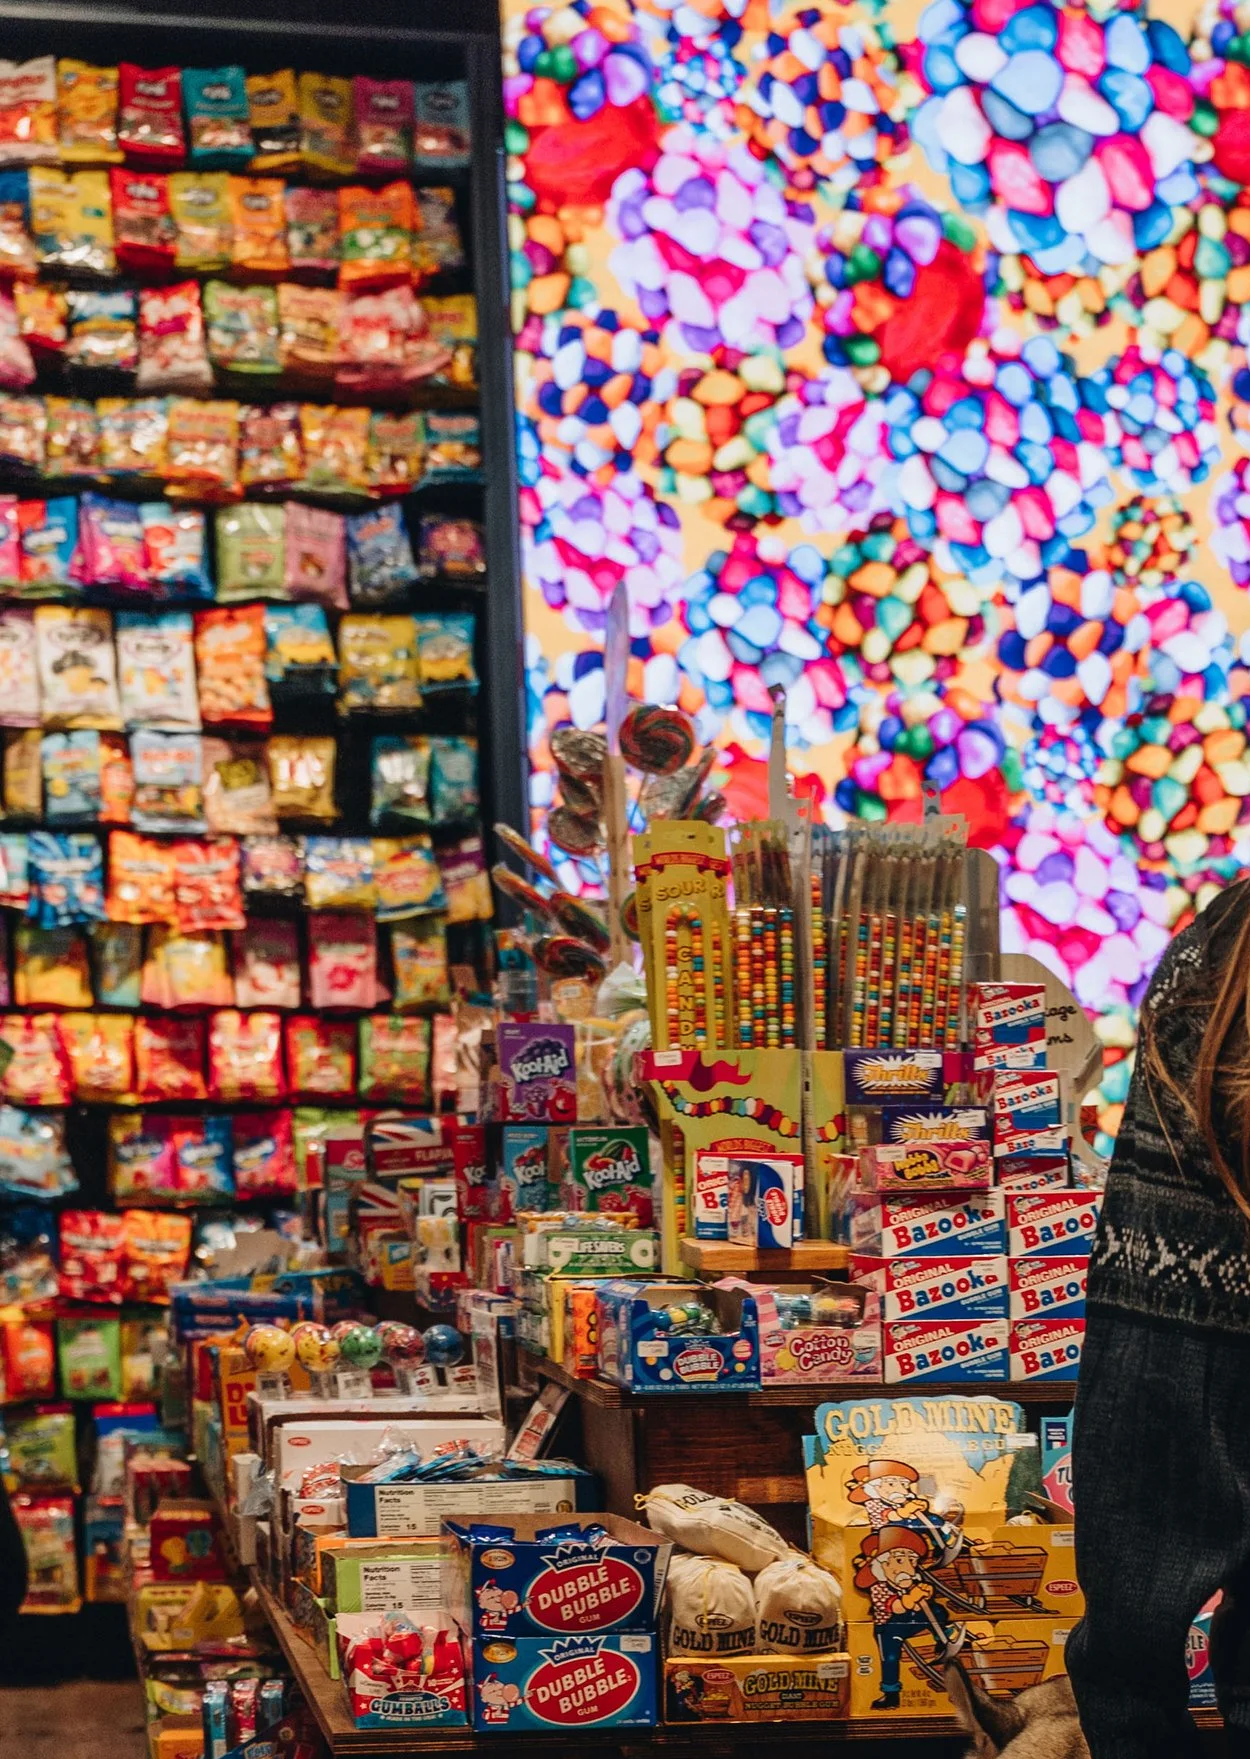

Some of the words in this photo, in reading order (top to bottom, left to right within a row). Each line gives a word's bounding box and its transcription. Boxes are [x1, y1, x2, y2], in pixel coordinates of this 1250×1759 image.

[656, 879, 706, 901] SOUR
[983, 999, 1040, 1024] Bazooka
[511, 1049, 570, 1082] Kool-Aid
[996, 1085, 1054, 1110] Bazooka
[584, 1154, 641, 1190] Kool-Aid
[889, 1199, 951, 1226] ORIGINAL
[1017, 1198, 1079, 1226] ORIGINAL
[892, 1203, 996, 1250] Bazooka
[893, 1262, 955, 1290] ORIGINAL
[1018, 1262, 1080, 1290] ORIGINAL
[895, 1269, 999, 1314] Bazooka
[790, 1334, 849, 1356] Cotton
[893, 1326, 955, 1353] ORIGINAL
[1018, 1325, 1080, 1352] ORIGINAL
[799, 1347, 853, 1371] Candy
[895, 1333, 999, 1377] Bazooka
[1020, 1343, 1080, 1376] Bazo
[824, 1401, 918, 1444] GOLD
[922, 1401, 1017, 1435] MINE
[556, 1553, 599, 1568] ORIGINAL
[537, 1565, 609, 1610] DUBBLE
[559, 1577, 631, 1622] BUBBLE
[578, 1613, 601, 1624] GUM
[672, 1625, 713, 1651] GOLD
[716, 1626, 756, 1651] MINE
[759, 1619, 802, 1645] GOLD
[803, 1624, 841, 1649] MINE
[553, 1646, 595, 1661] ORIGINAL
[535, 1658, 606, 1704] DUBBLE
[558, 1667, 627, 1714] BUBBLE
[744, 1670, 791, 1696] GOLD
[793, 1670, 840, 1693] MINE
[370, 1697, 450, 1715] GUMBALLS
[576, 1705, 599, 1717] GUM
